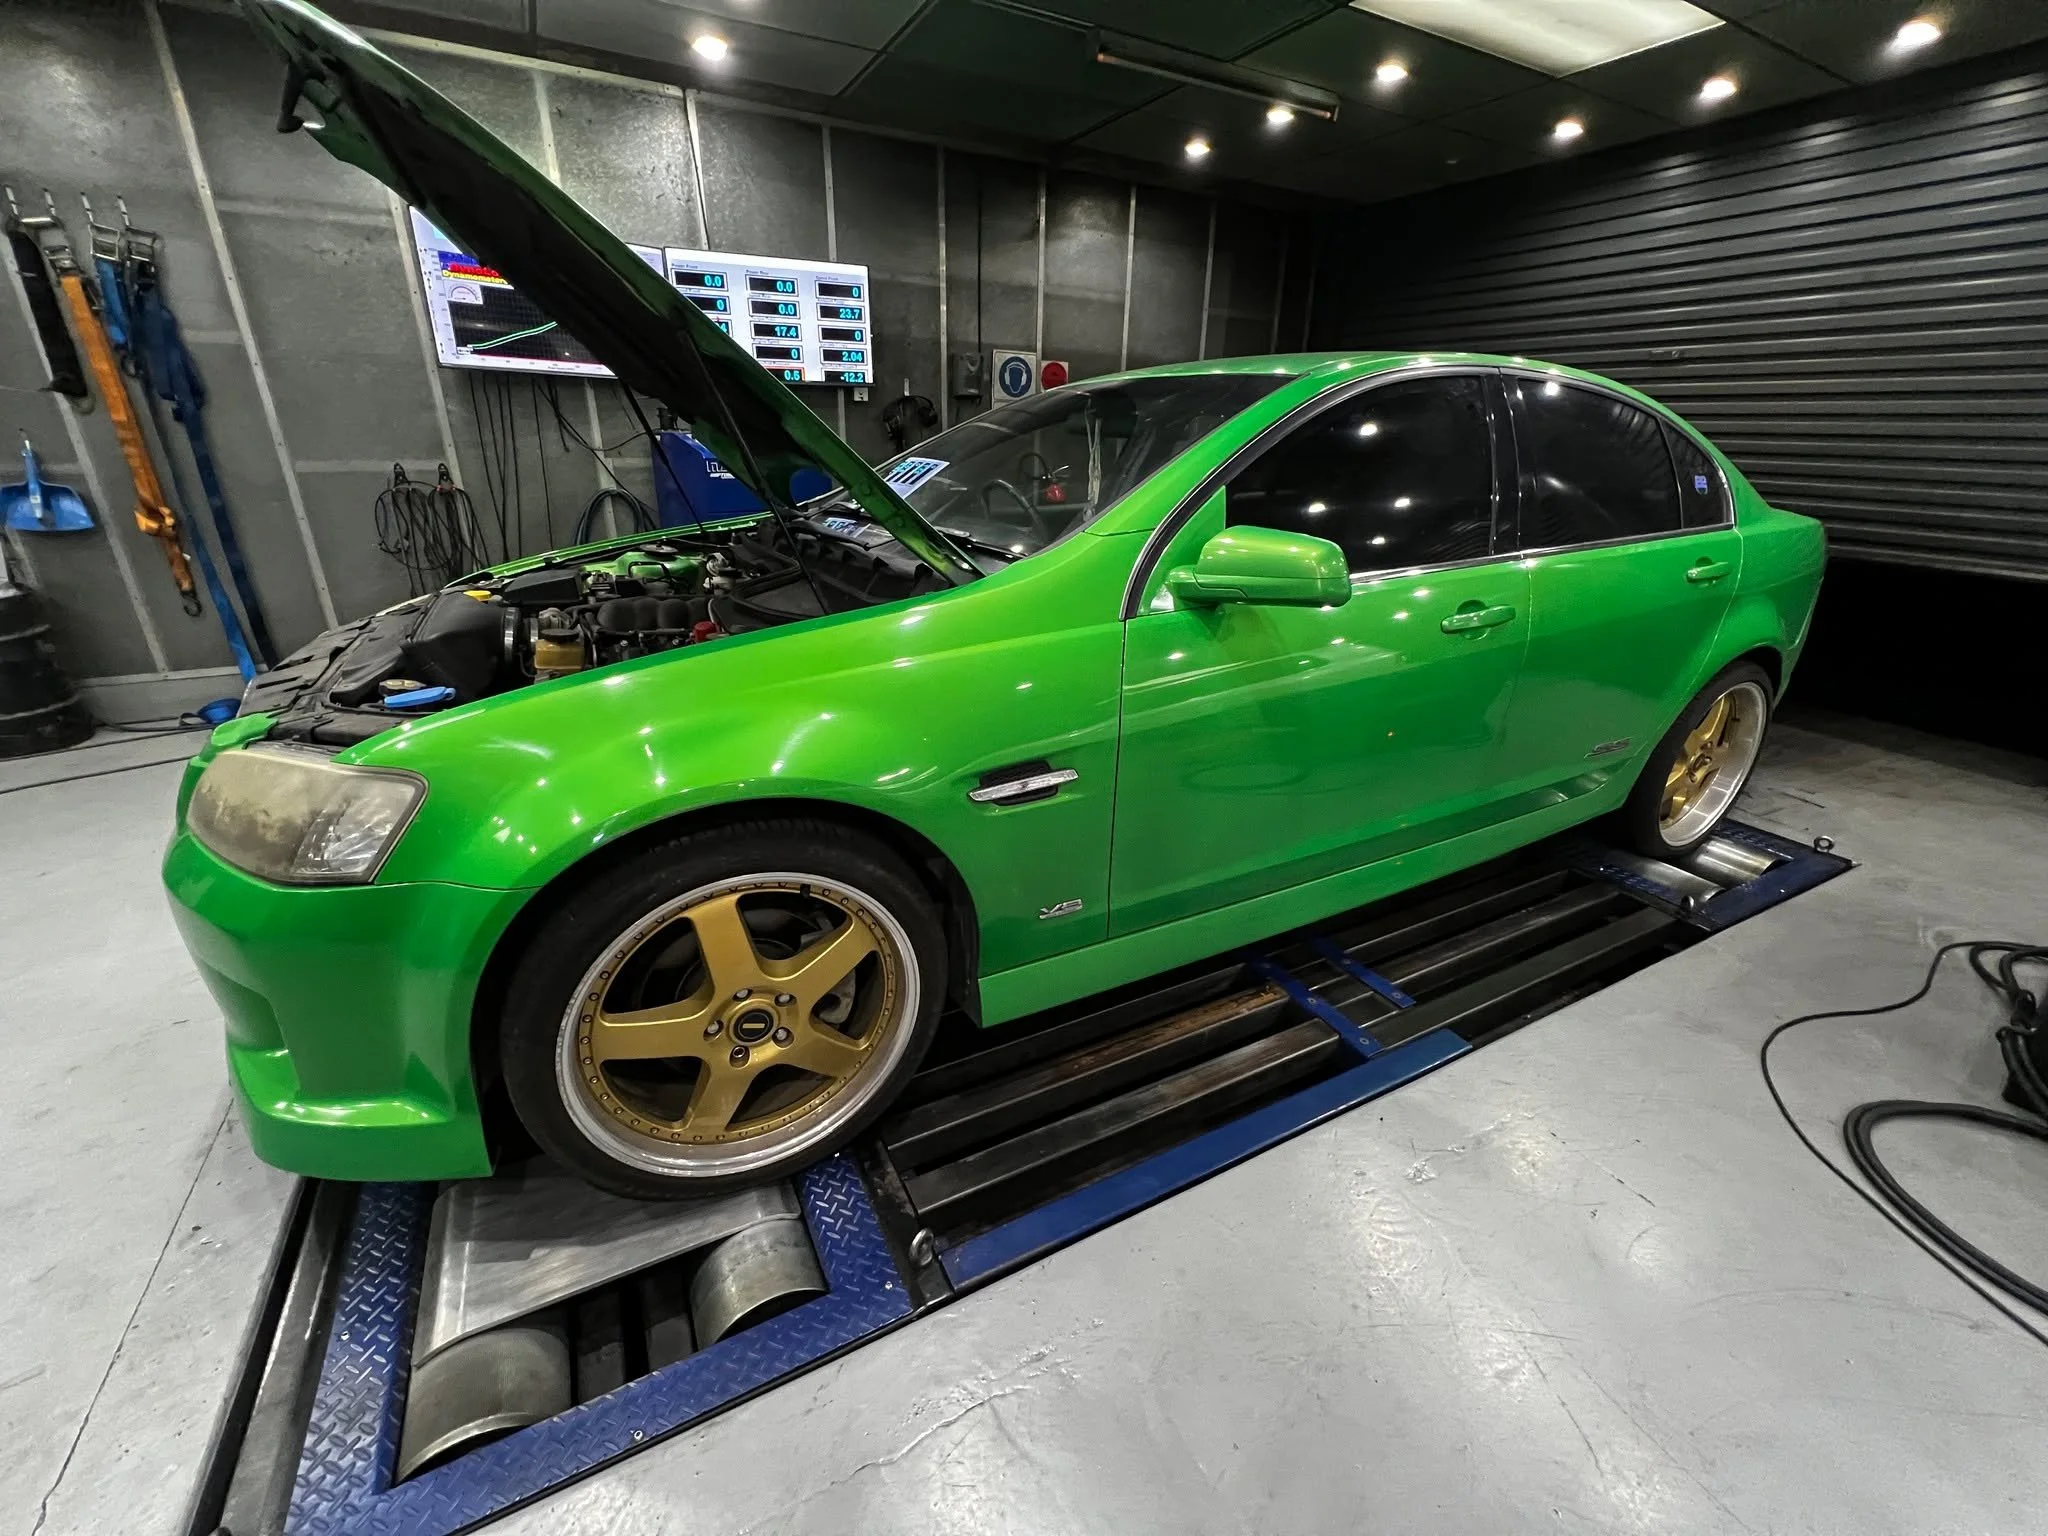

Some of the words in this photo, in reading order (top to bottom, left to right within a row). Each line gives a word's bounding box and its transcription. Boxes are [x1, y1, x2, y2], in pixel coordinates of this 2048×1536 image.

[704, 274, 722, 287] 0.0
[776, 281, 793, 293] 0.0
[852, 286, 859, 298] 0
[716, 299, 725, 311] 0
[778, 303, 795, 315] 0.0
[839, 308, 860, 319] 23.7
[775, 326, 797, 338] 17.4
[854, 330, 862, 341] 0
[790, 348, 798, 360] 0
[842, 352, 863, 362] 2.04
